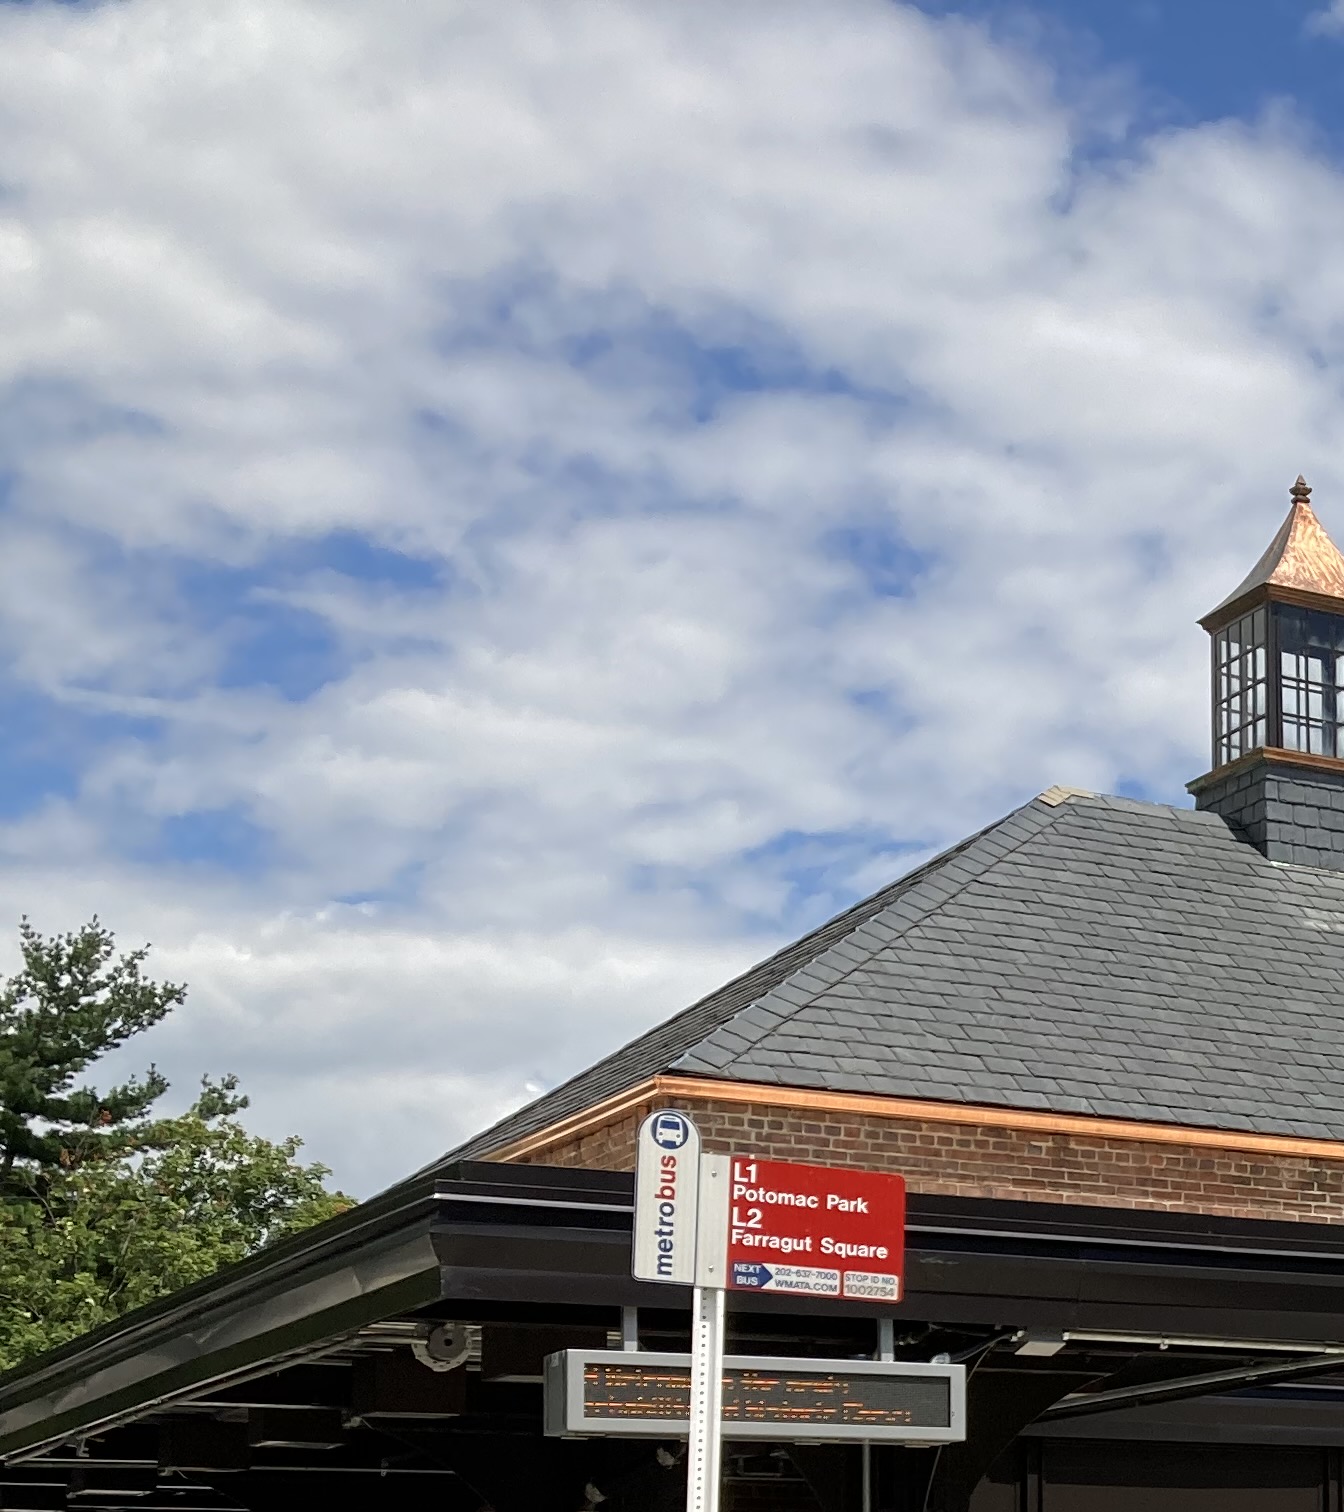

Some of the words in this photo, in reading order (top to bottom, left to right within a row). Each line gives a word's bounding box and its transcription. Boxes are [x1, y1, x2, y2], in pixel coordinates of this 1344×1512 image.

[733, 1162, 757, 1183] L1
[732, 1184, 819, 1208] Potomac
[826, 1194, 869, 1214] Park
[654, 1155, 677, 1275] metrobus
[732, 1206, 762, 1229] L2
[731, 1229, 812, 1253] Farragut
[820, 1238, 888, 1259] Square
[733, 1263, 761, 1274] NEXT
[774, 1267, 838, 1281] 202-637-7000
[736, 1275, 758, 1286] BUS
[845, 1273, 869, 1283] STOP
[870, 1275, 880, 1284] ID
[775, 1279, 838, 1293] WMATA.COM
[844, 1284, 895, 1298] 1002754
